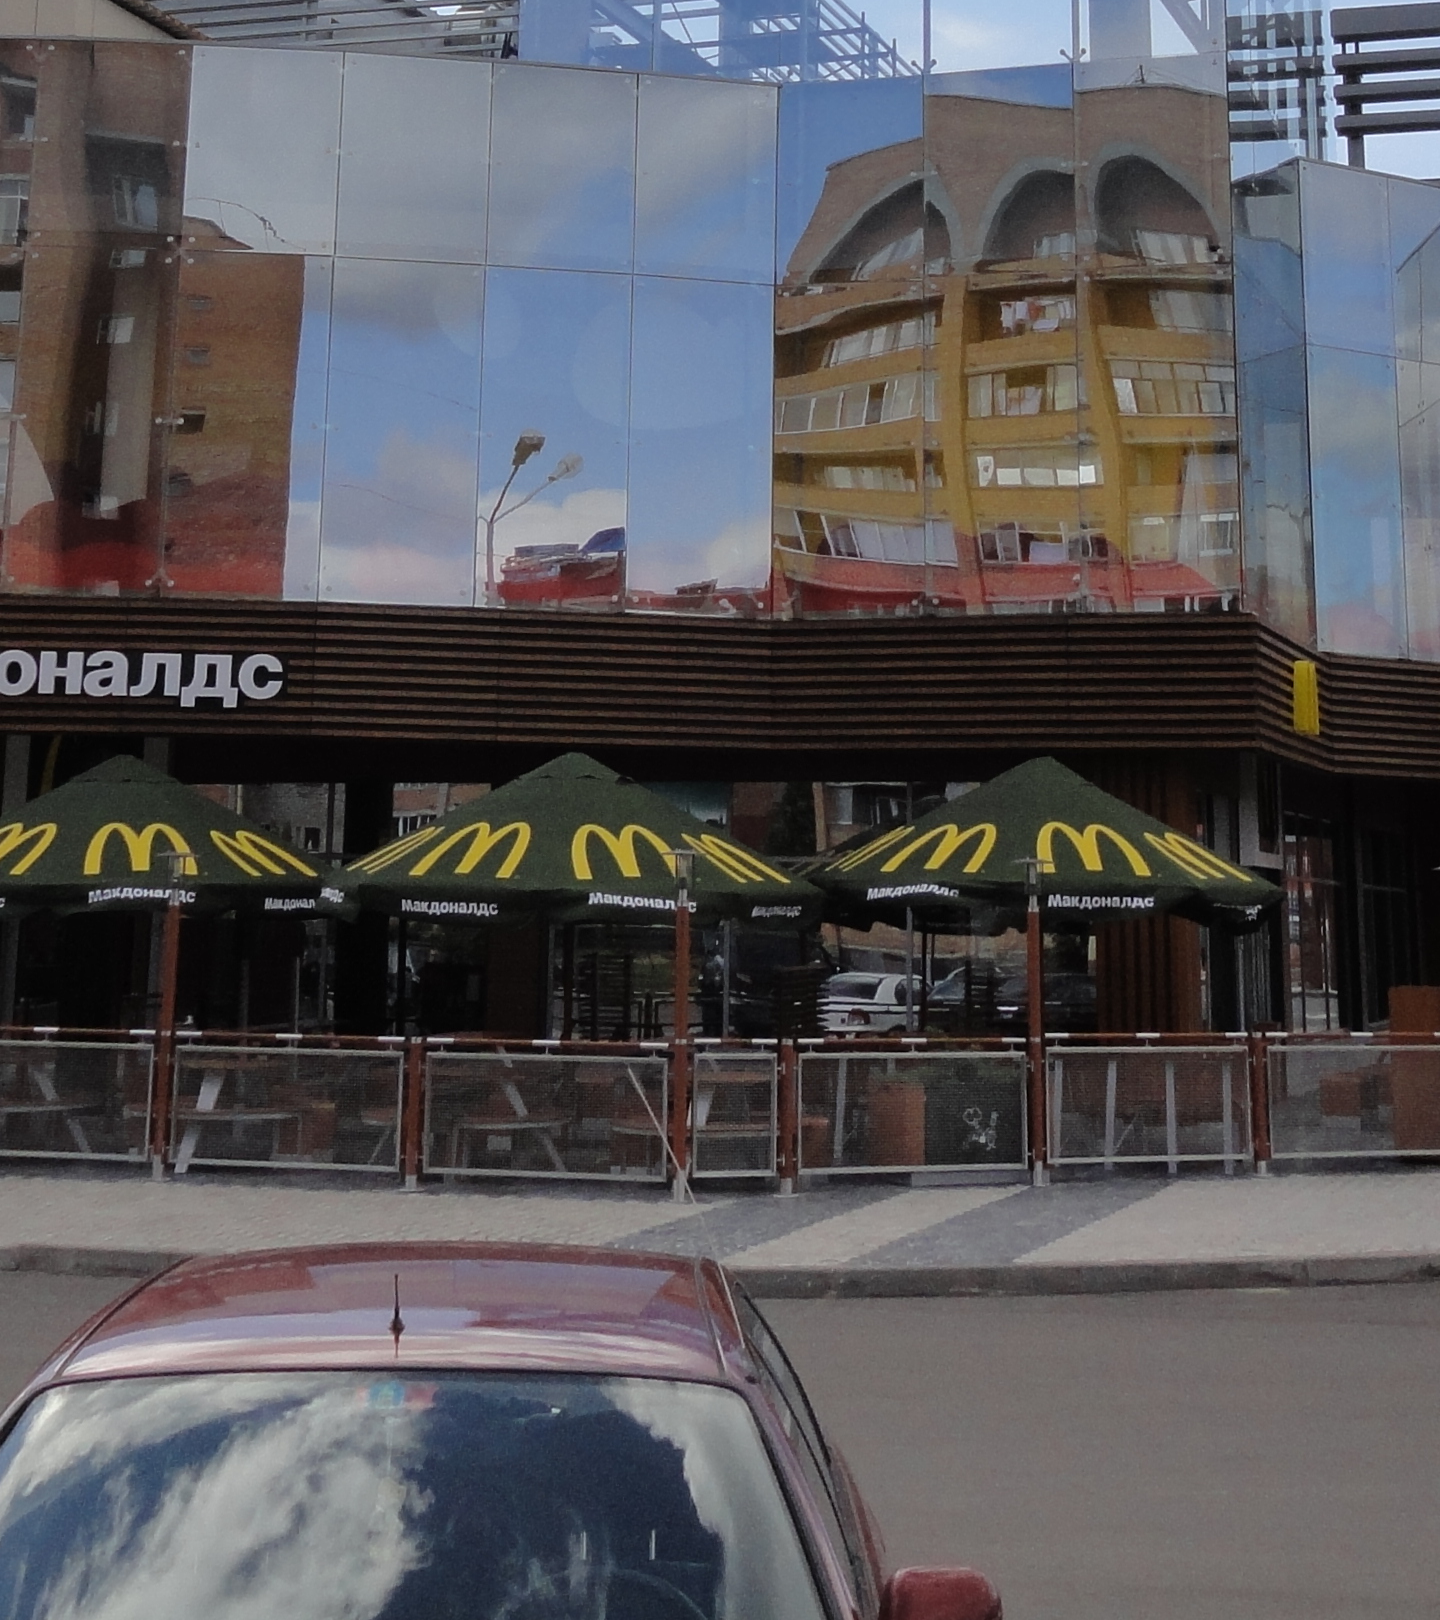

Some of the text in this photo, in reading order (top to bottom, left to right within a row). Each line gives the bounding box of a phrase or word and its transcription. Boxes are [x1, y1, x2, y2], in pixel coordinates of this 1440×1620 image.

[866, 883, 960, 901] Макдоналдс
[264, 897, 316, 911] Макдонал
[401, 898, 498, 915] Макдоналдс
[587, 891, 697, 913] Макдоналс
[1047, 893, 1155, 911] Макдоналдс
